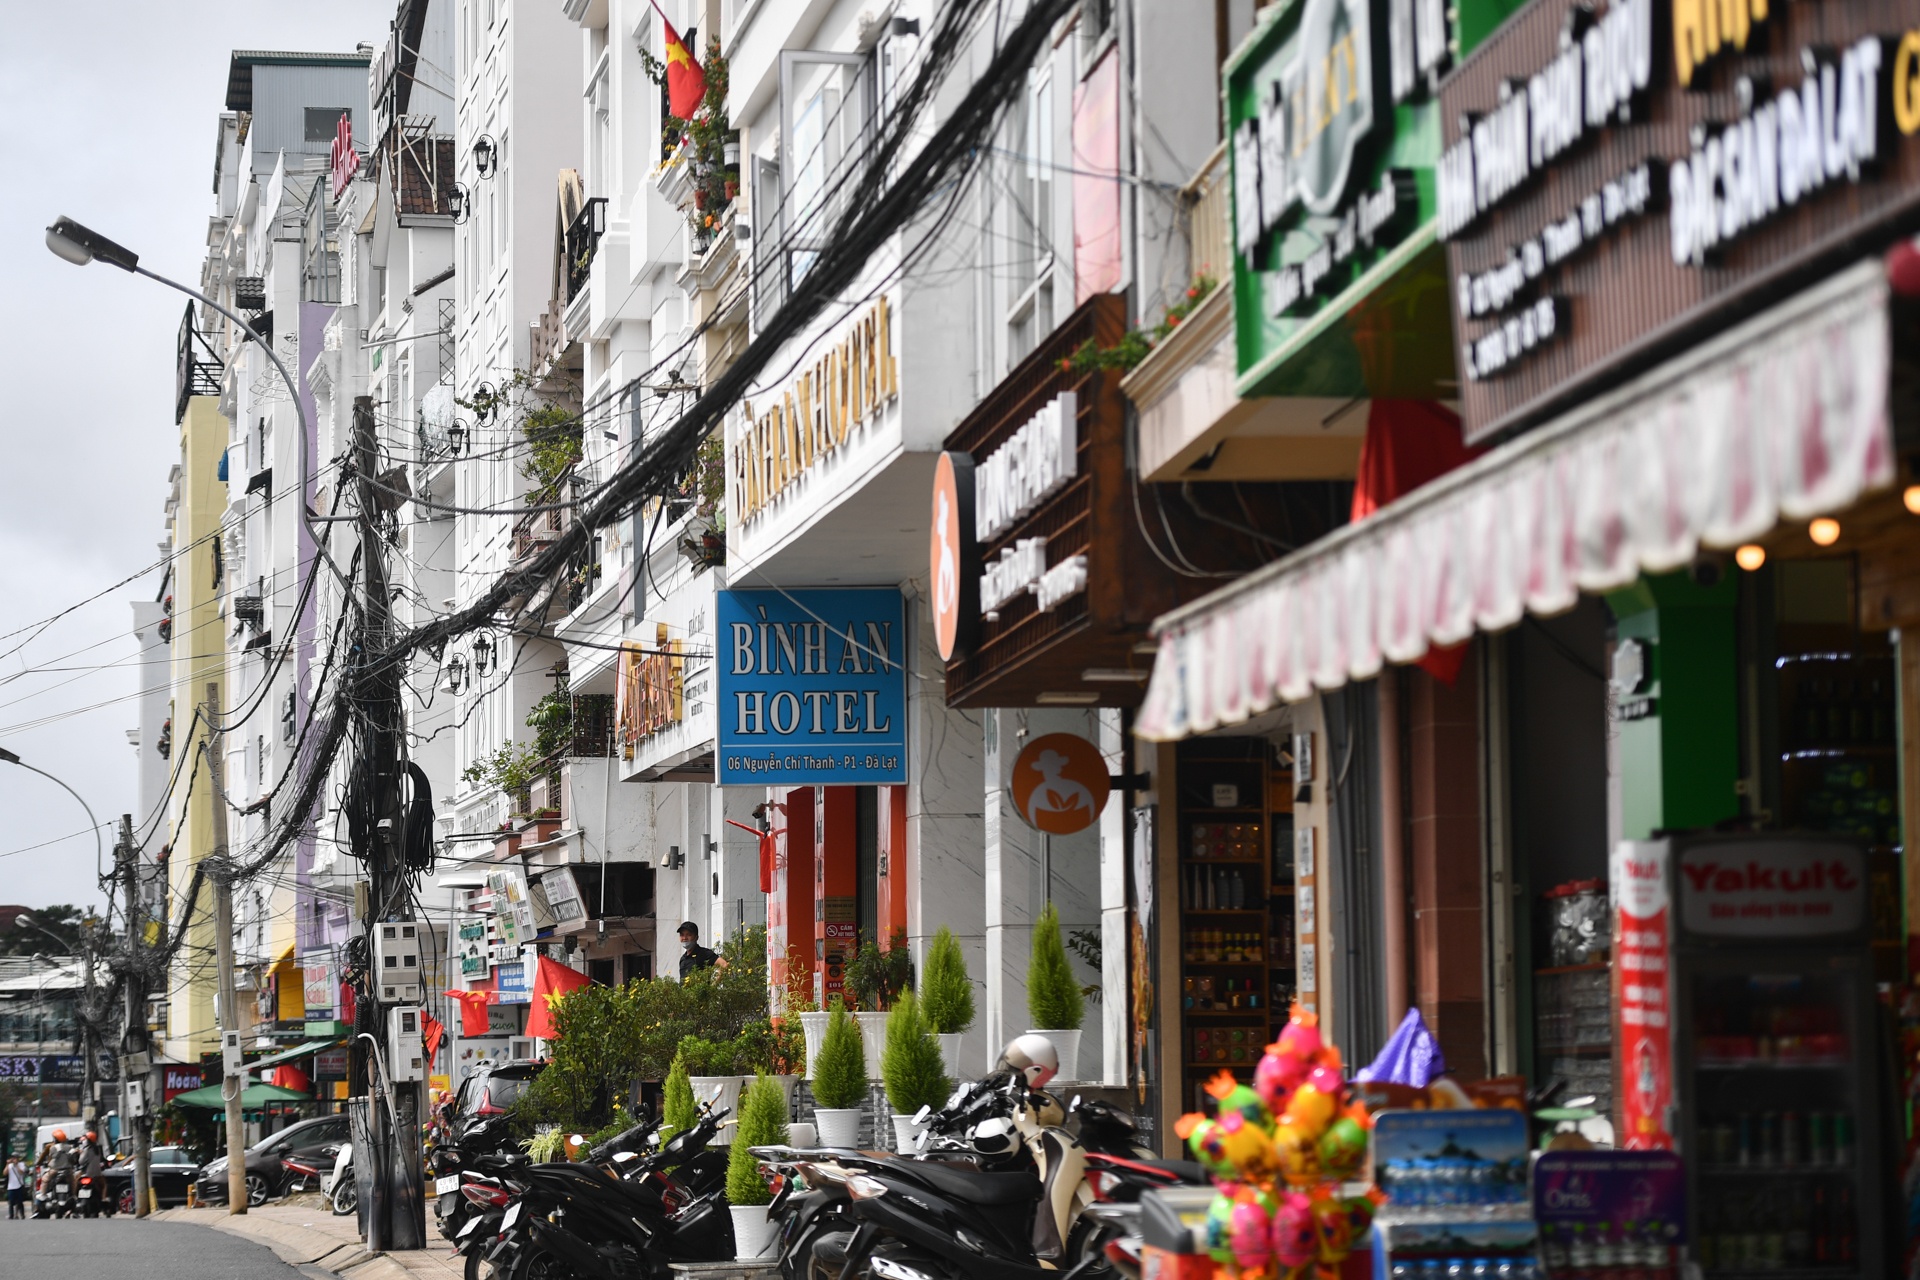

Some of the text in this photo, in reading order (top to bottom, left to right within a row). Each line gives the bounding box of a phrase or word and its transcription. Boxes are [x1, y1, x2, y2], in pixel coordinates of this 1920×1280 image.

[734, 399, 784, 528] BÌNH
[781, 368, 814, 490] AN
[812, 294, 898, 463] HOTEL
[730, 604, 830, 675] BÌNH
[838, 620, 892, 675] AN
[734, 690, 891, 735] HOTEL
[727, 756, 741, 770] 06
[743, 752, 782, 773] Nguyễn
[803, 755, 835, 769] Thanh
[844, 755, 857, 769] P1
[865, 755, 879, 769] Đà
[881, 754, 898, 772] Lạt
[1682, 860, 1859, 893] Yakult
[0, 1057, 46, 1075] SKY
